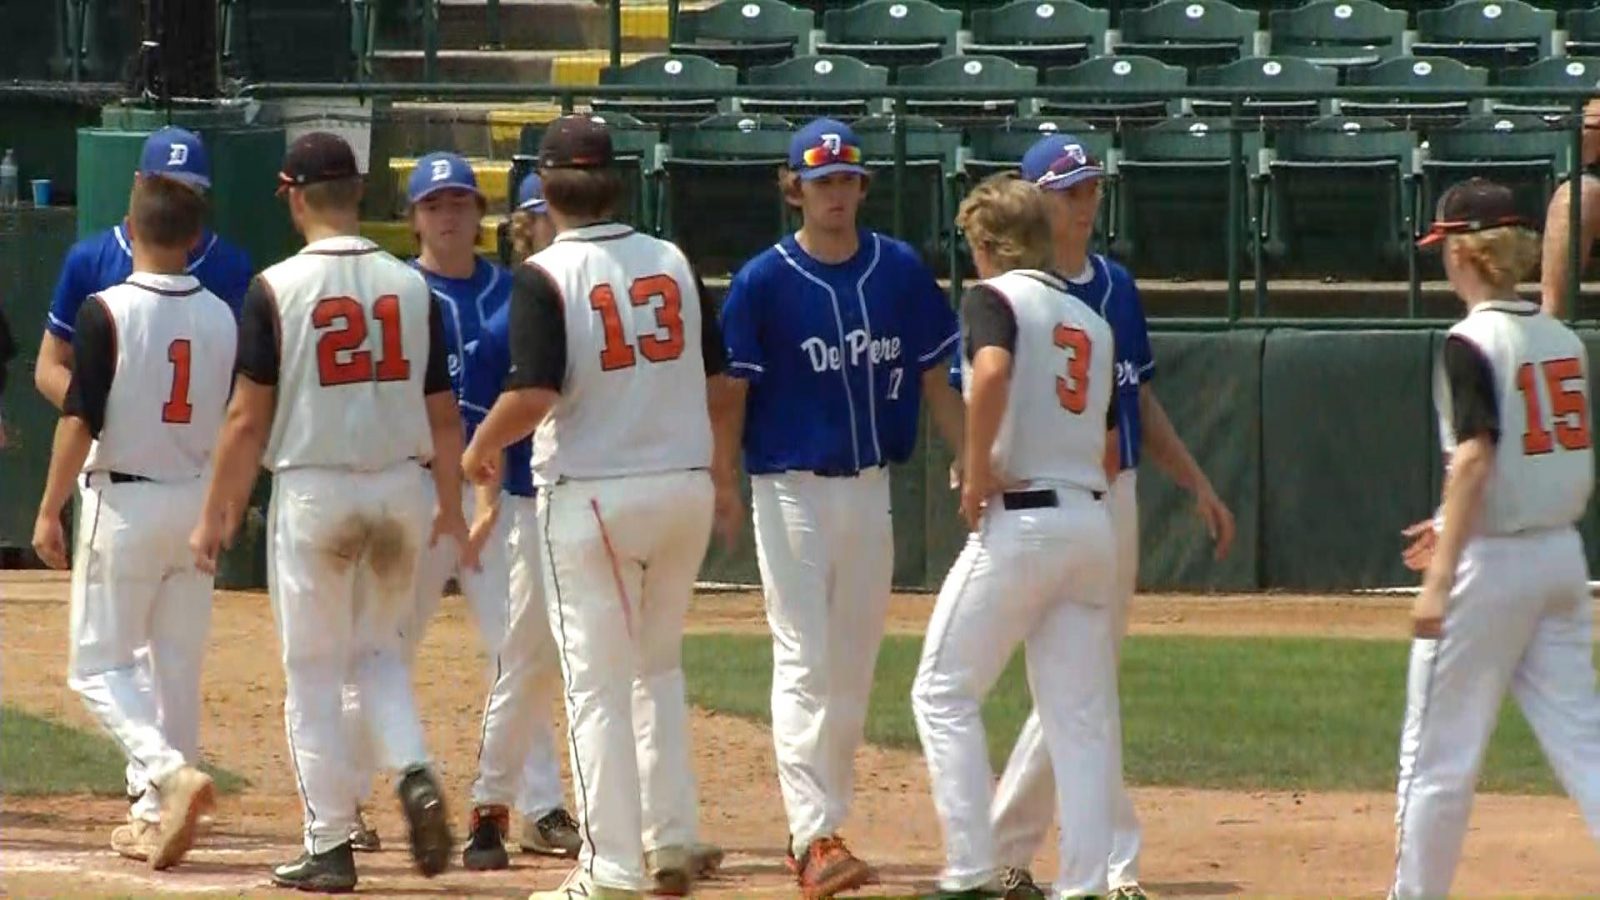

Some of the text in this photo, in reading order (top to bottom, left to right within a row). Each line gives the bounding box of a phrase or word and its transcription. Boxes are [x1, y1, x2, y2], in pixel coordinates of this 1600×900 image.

[167, 143, 188, 165] D
[431, 159, 451, 182] D
[311, 294, 410, 386] 21
[590, 274, 684, 371] 13
[800, 329, 901, 372] De Pere
[162, 339, 192, 423] 1
[1053, 321, 1091, 414] 3
[1516, 357, 1591, 455] 15
